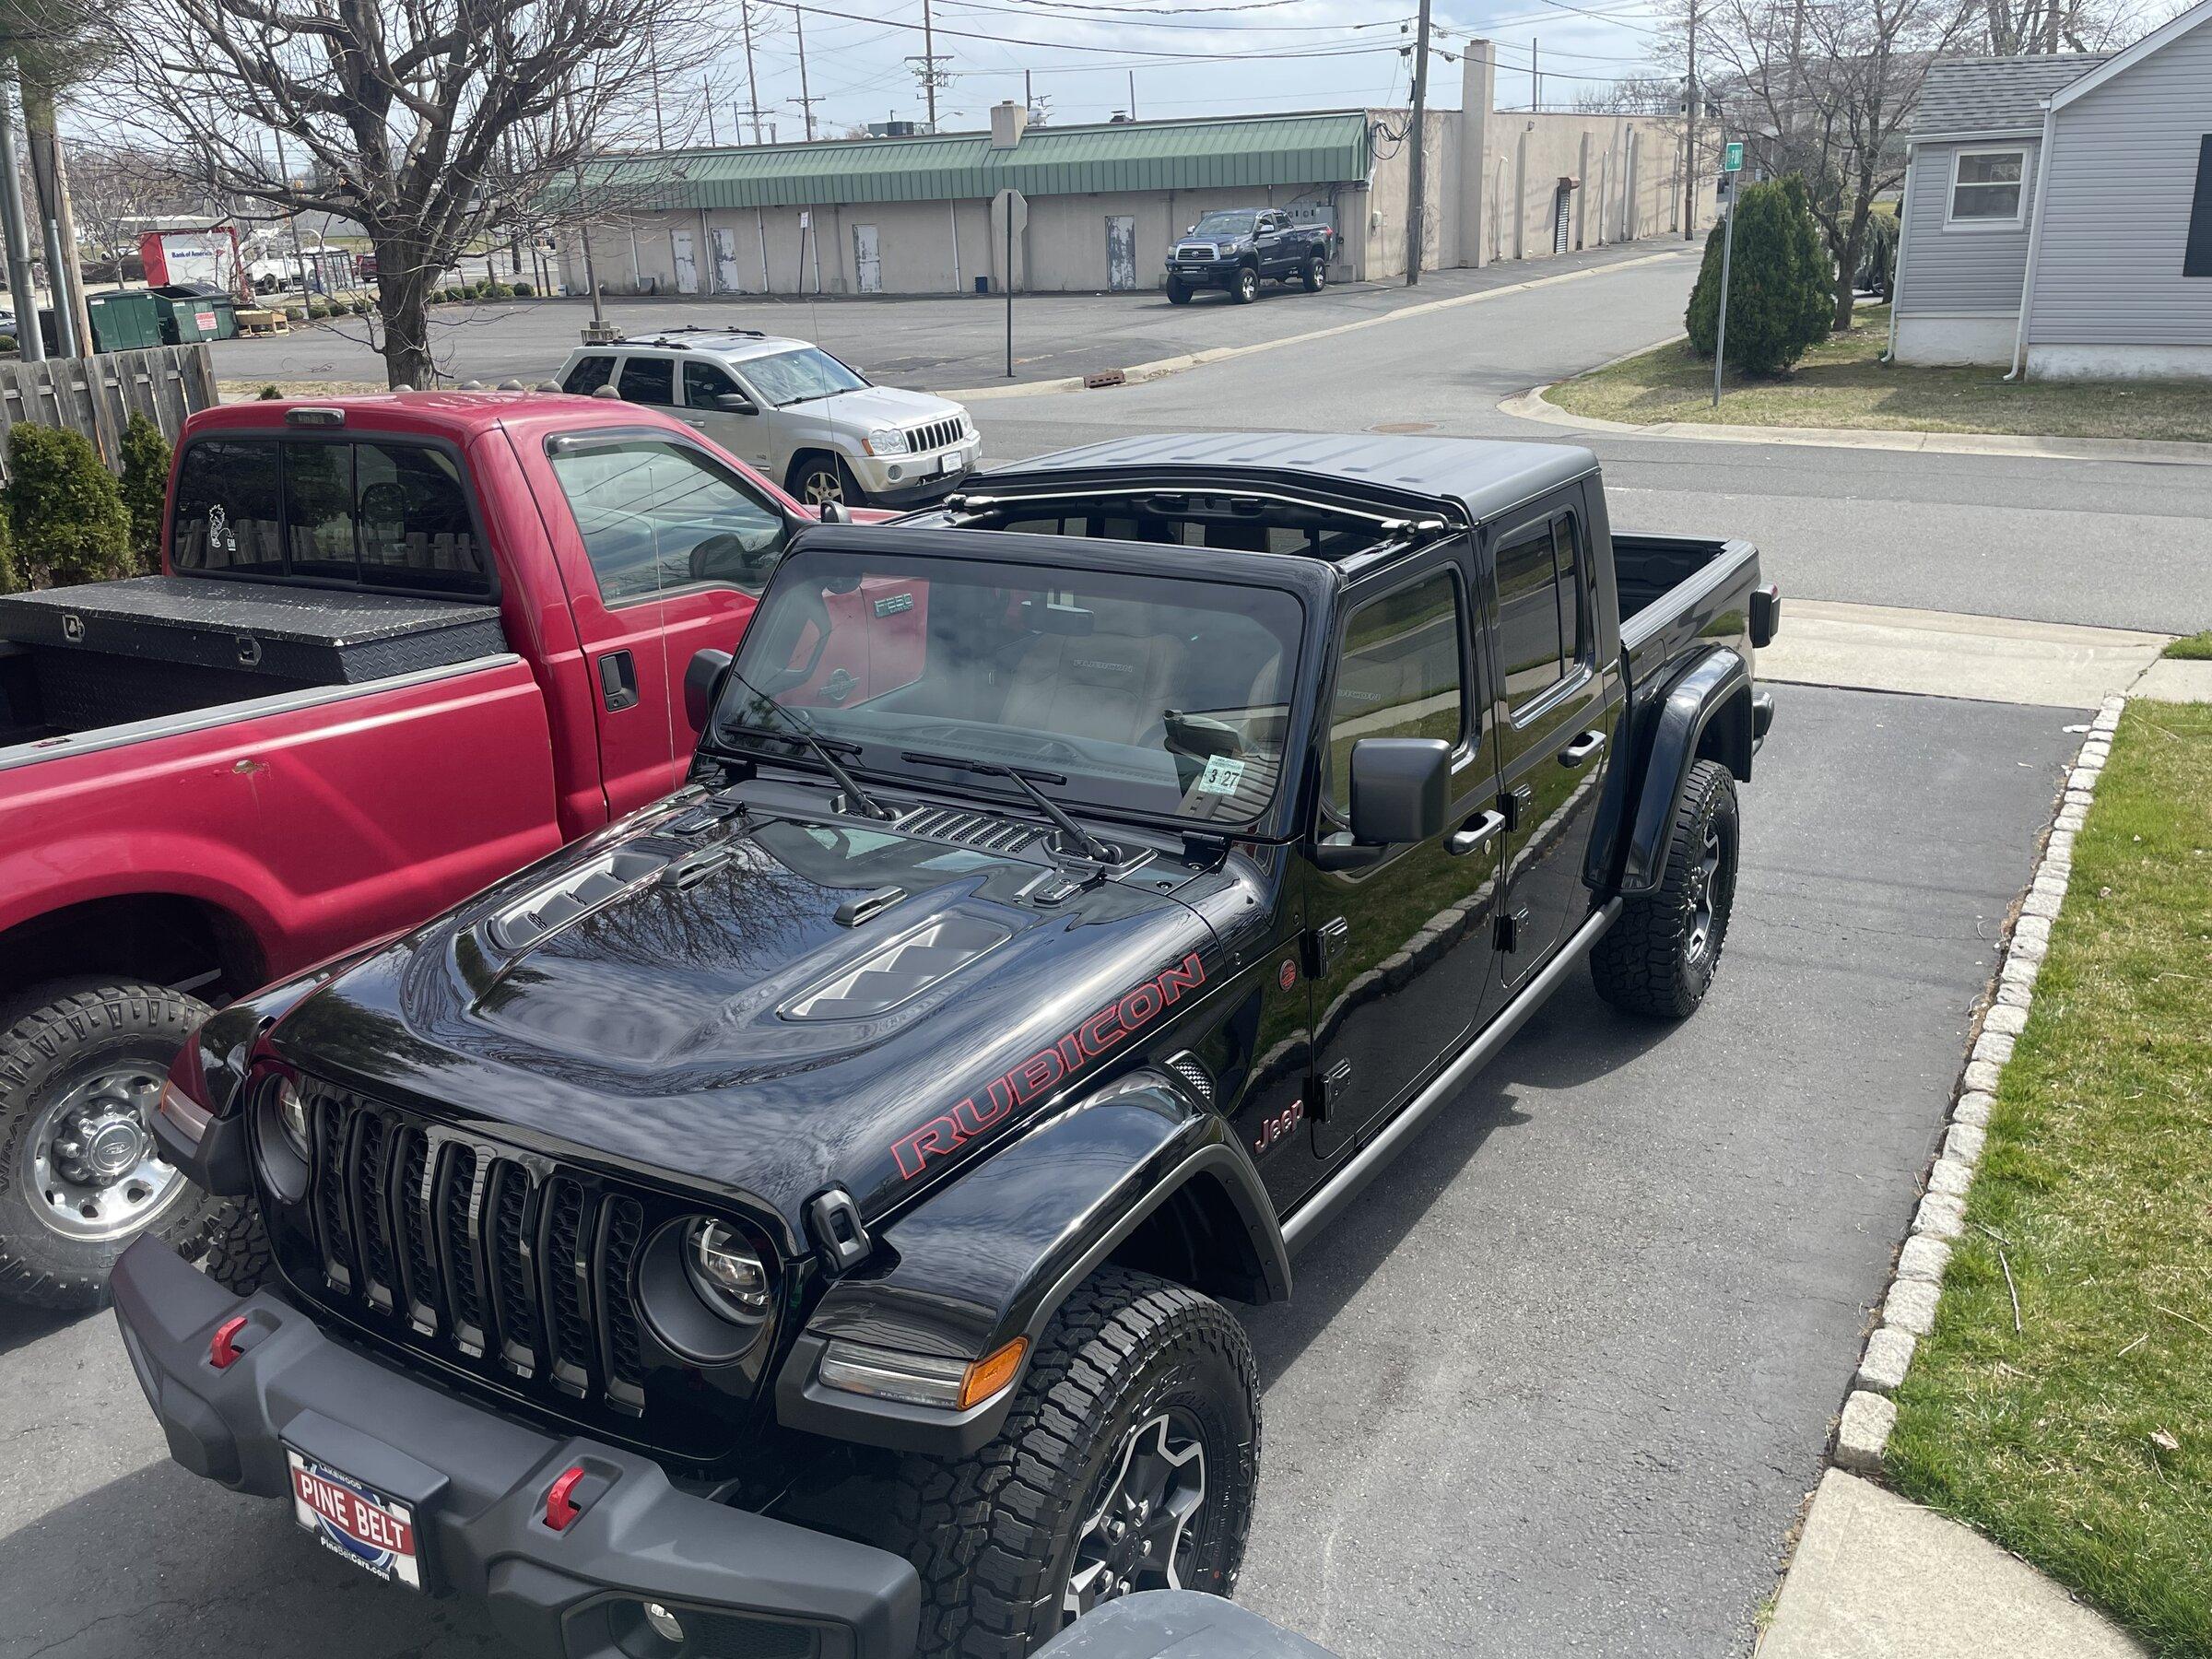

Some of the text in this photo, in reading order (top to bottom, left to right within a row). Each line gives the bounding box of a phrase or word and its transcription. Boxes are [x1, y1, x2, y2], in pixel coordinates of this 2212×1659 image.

[1208, 769, 1241, 788] 3 27
[889, 951, 1207, 1181] RUBICON
[1253, 1099, 1304, 1154] Jeep
[301, 1474, 404, 1549] PINE BELT
[321, 1536, 390, 1582] PineBeltCars.com
